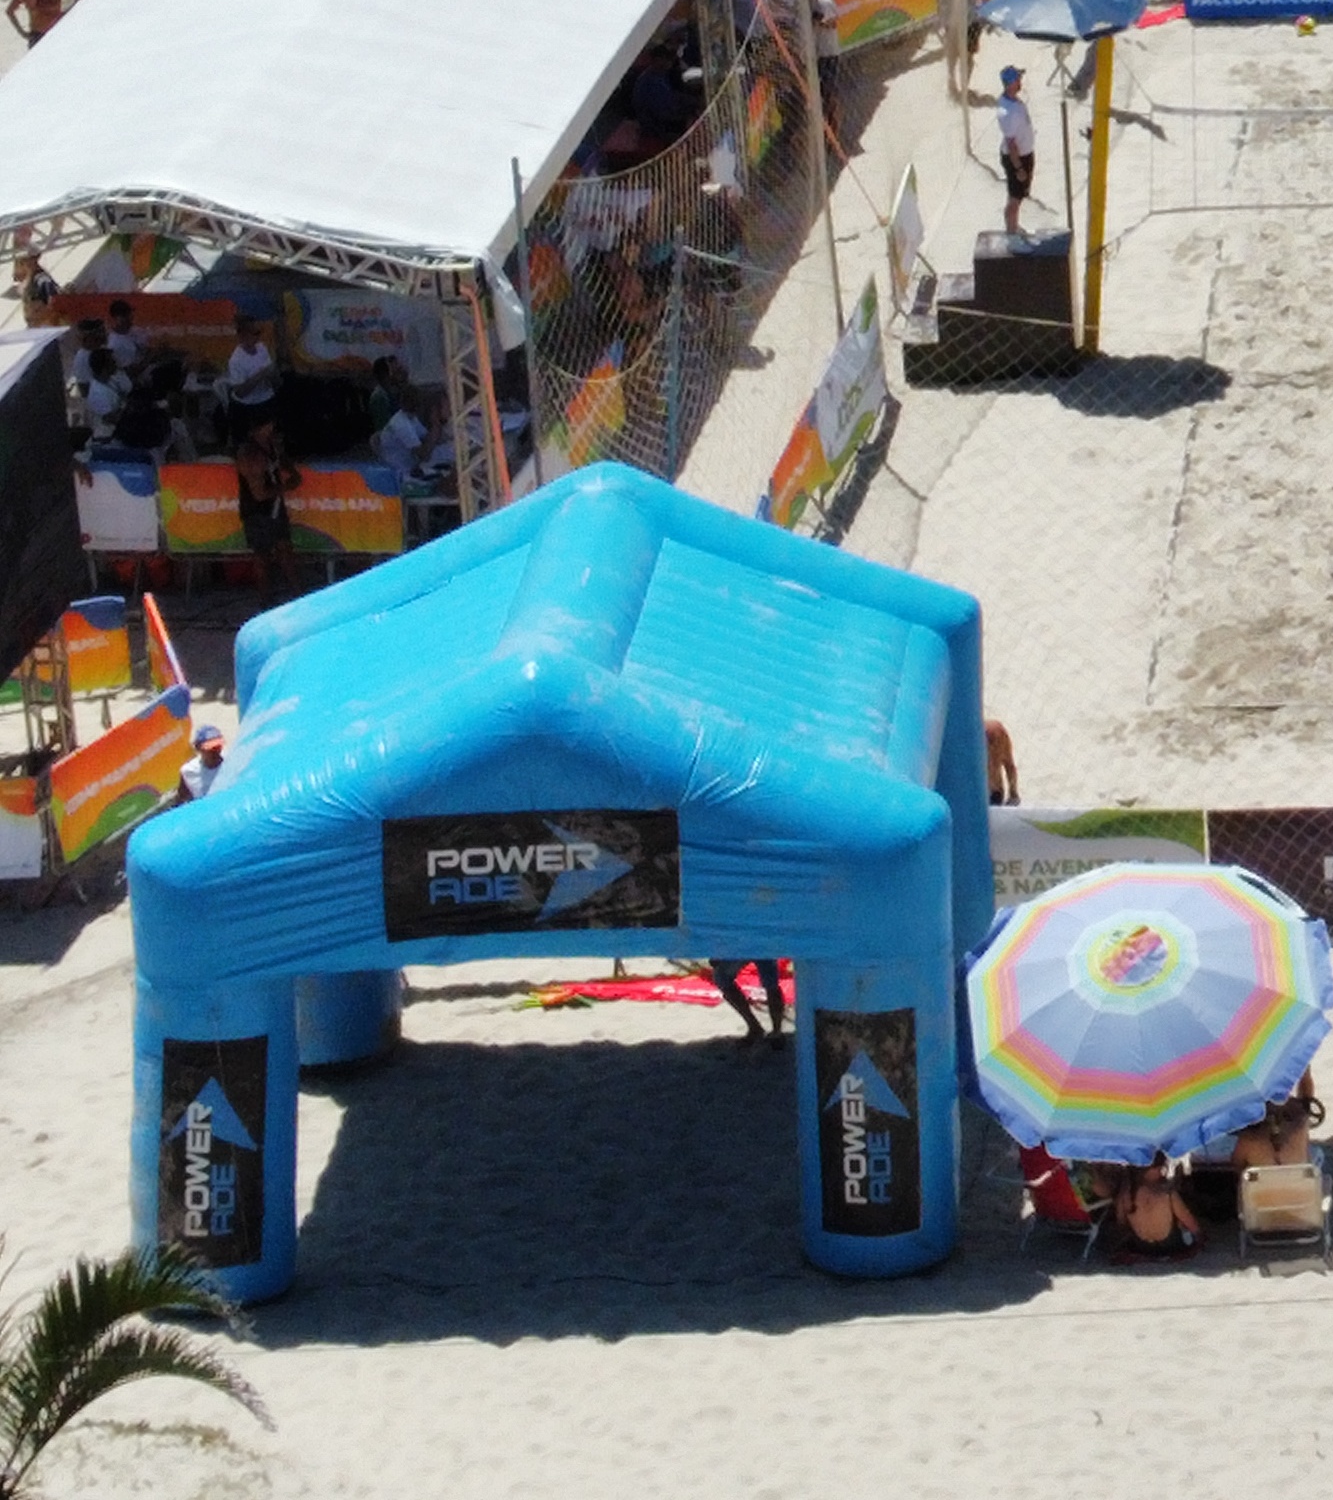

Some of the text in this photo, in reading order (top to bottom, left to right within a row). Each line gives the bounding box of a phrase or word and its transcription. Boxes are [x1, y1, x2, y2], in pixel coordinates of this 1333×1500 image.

[427, 843, 601, 877] POWER
[993, 860, 1022, 876] DE
[184, 1101, 213, 1237] POWER
[841, 1072, 868, 1204] POWER
